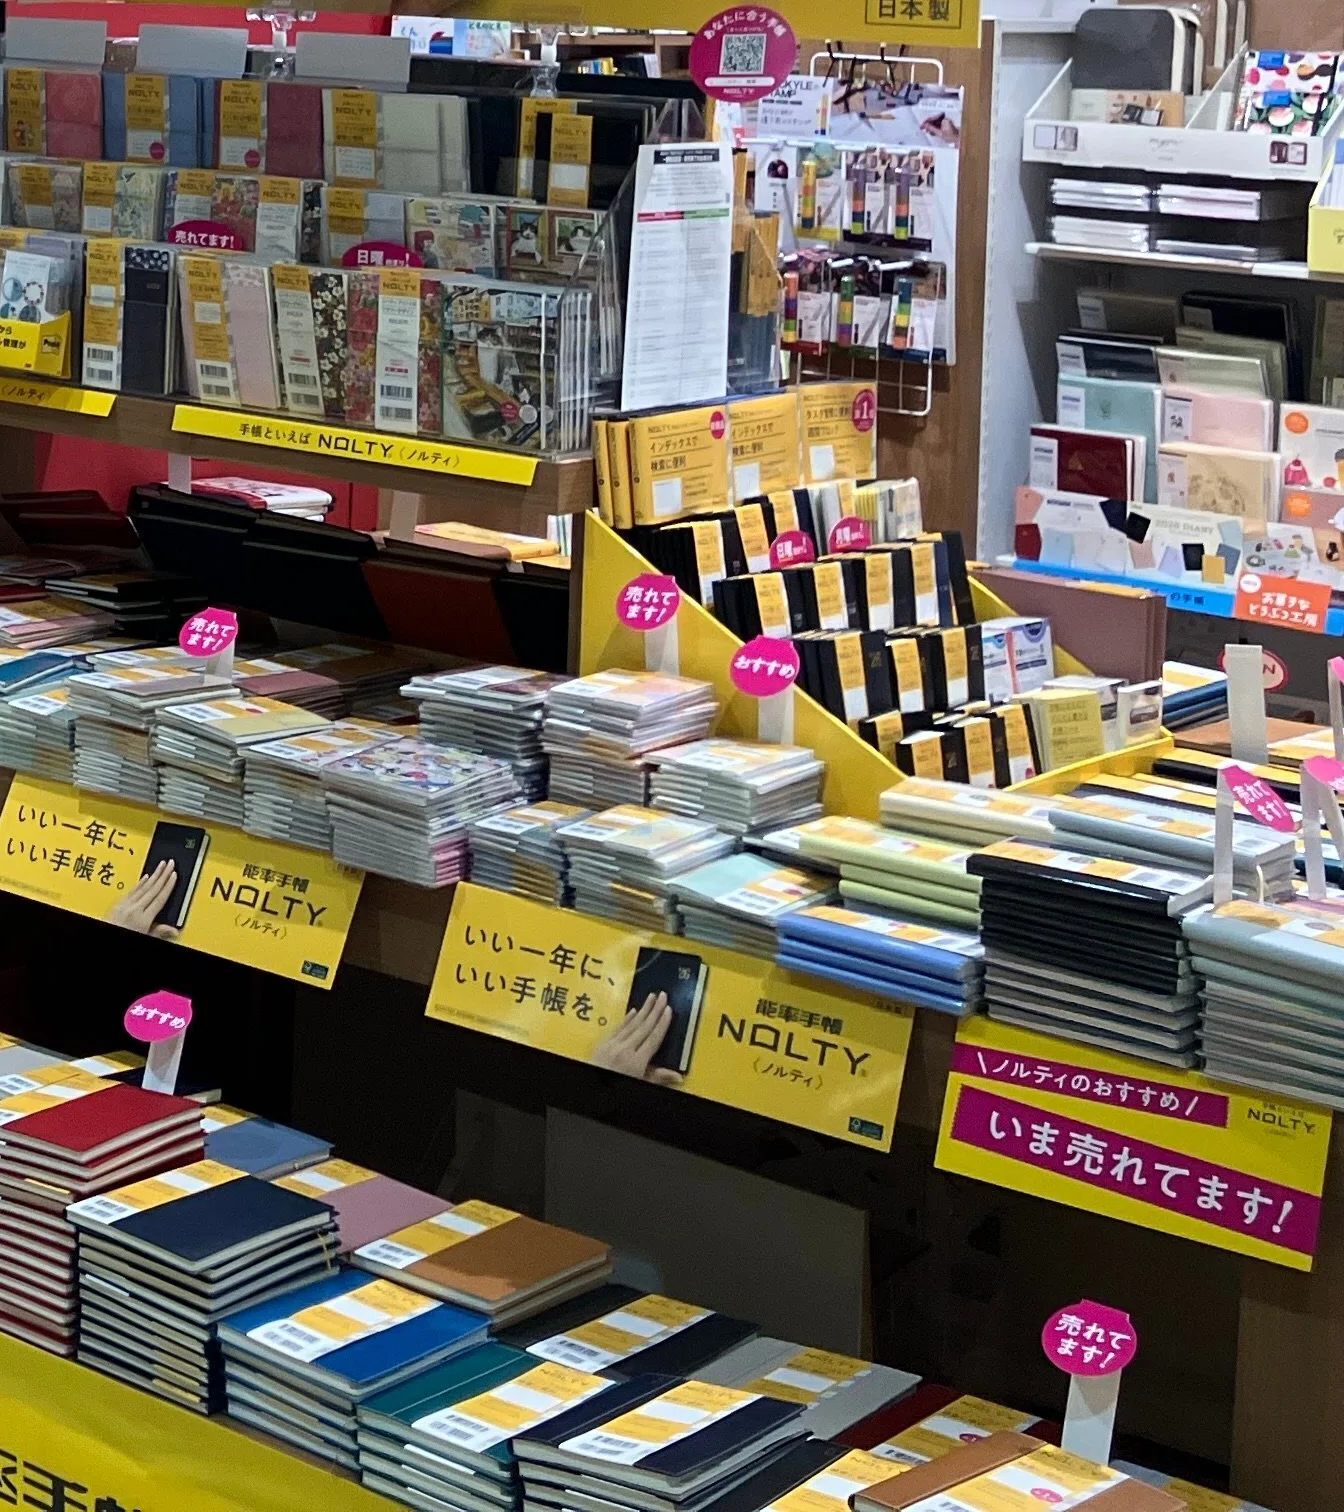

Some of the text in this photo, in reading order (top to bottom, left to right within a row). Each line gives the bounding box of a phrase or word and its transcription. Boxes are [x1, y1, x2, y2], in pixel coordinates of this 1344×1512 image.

[174, 229, 236, 249] 売れてます！
[239, 422, 312, 445] 手帳といえば
[317, 433, 393, 458] NOLTY
[624, 586, 678, 606] 売れて
[624, 603, 668, 621] ます！
[184, 631, 225, 651] ます！
[187, 615, 237, 639] 売れて
[733, 654, 797, 680] おすすめ
[17, 802, 137, 858] いい一年に、
[5, 836, 126, 892] いい手帳を。
[242, 862, 312, 896] 能率手帳
[210, 875, 328, 927] NOLTY
[464, 924, 617, 987] いい一年に、
[454, 962, 610, 1028] いい手帳を。
[128, 1000, 187, 1032] おすすめ
[755, 997, 845, 1036] 能率手帳
[717, 1013, 873, 1077] NOLTY
[989, 1055, 1184, 1111] ノルティのおすすめ
[1247, 1107, 1316, 1133] NOLTY
[989, 1107, 1295, 1234] いま売れてます！
[1053, 1313, 1132, 1353] 売れて
[1055, 1336, 1116, 1370] ます！
